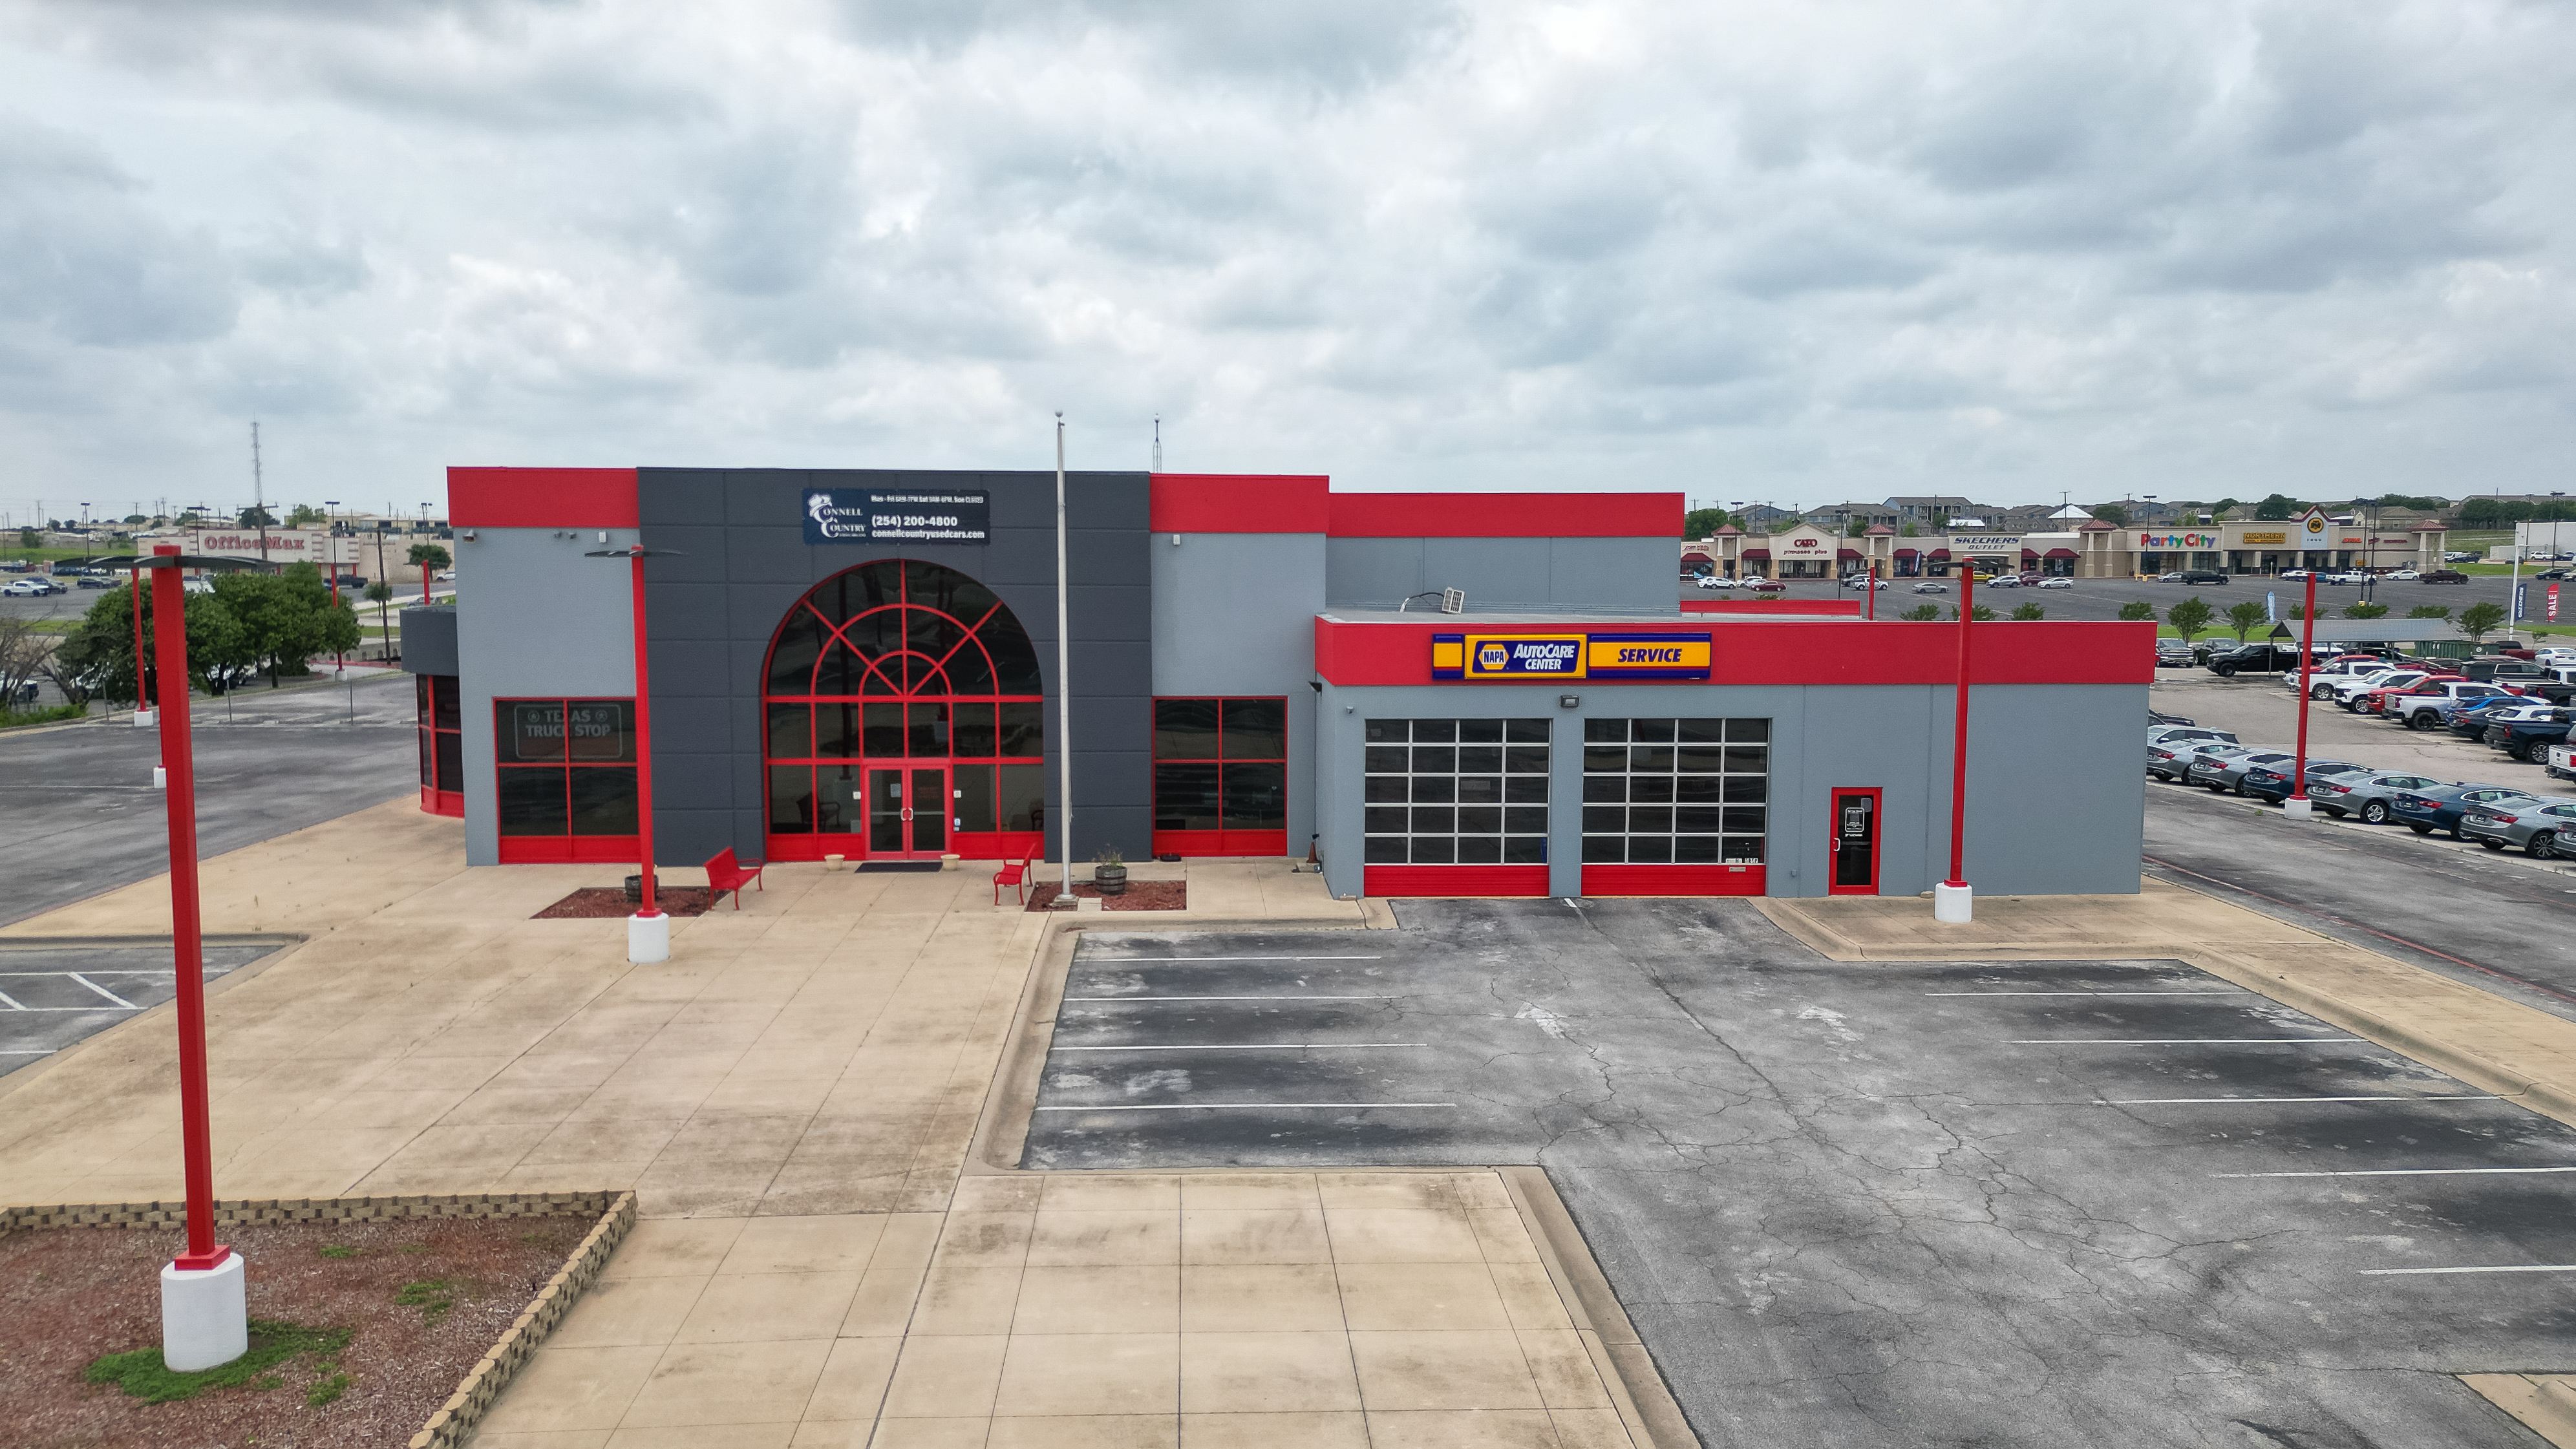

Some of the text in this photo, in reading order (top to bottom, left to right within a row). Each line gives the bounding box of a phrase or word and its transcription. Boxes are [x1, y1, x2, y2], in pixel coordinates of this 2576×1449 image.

[813, 503, 863, 522] CONNELL
[872, 515, 958, 527] (254) 200-4800
[820, 521, 866, 538] COUNTRY
[872, 529, 985, 540] connellcountryusedcars.com
[1794, 538, 1818, 547] CATO
[1483, 651, 1506, 664] NAPA
[1617, 648, 1683, 663] SERVICE
[1525, 659, 1562, 670] CENTER
[575, 724, 612, 737] STOP
